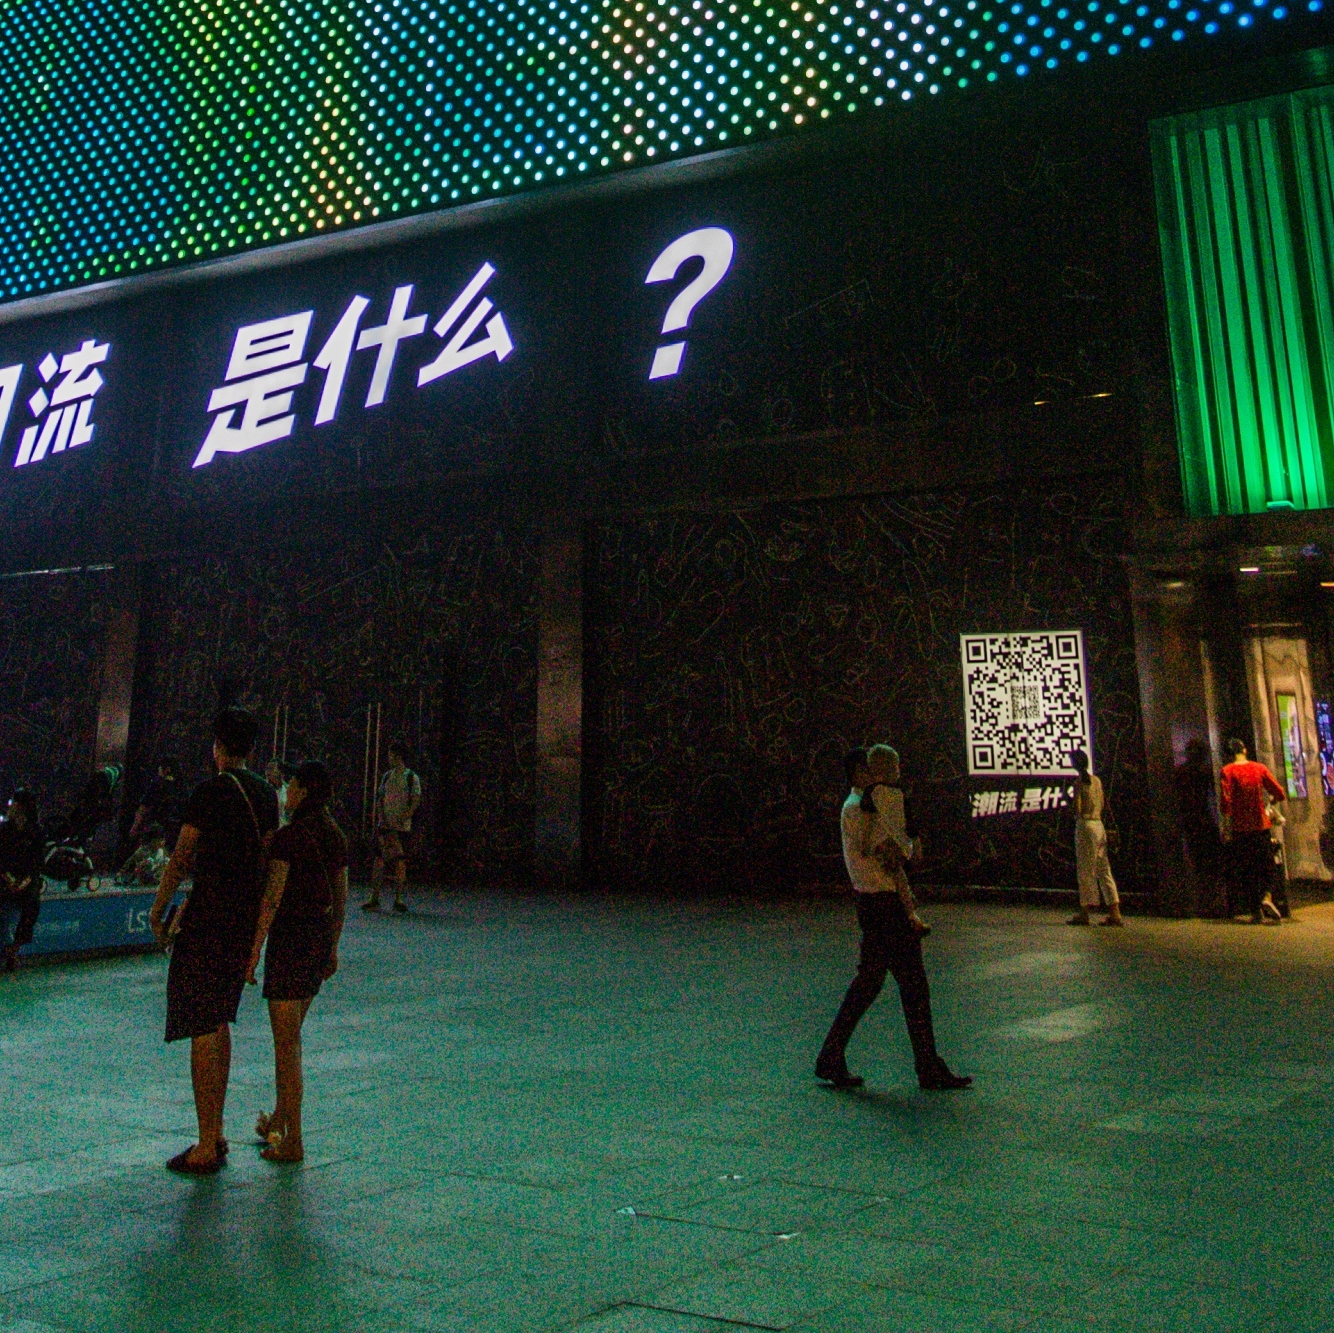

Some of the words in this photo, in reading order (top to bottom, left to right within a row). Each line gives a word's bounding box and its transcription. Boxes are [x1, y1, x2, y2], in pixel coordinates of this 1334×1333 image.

[192, 261, 515, 469] 是什么
[971, 790, 1018, 817] 潮流
